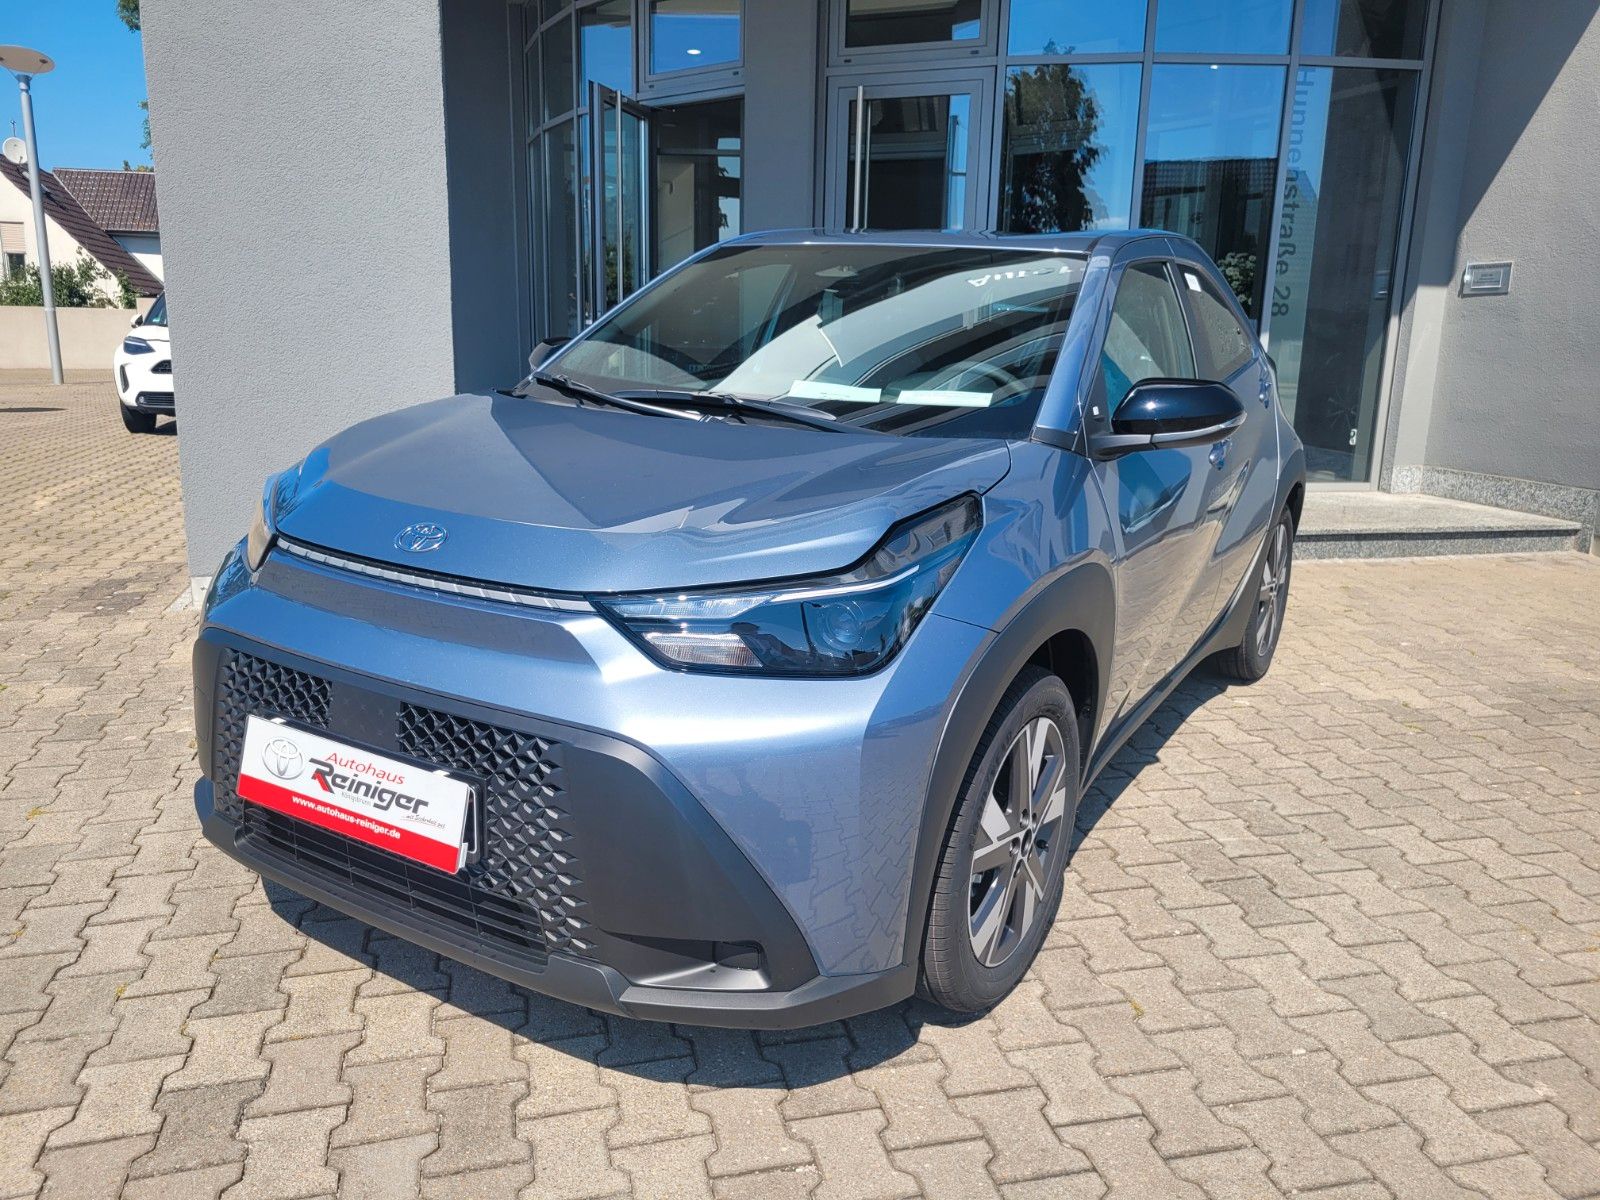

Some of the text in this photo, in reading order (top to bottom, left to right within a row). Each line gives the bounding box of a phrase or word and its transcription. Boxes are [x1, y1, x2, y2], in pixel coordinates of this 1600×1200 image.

[1271, 68, 1314, 317] Hunnenstraße 28
[308, 757, 430, 815] Reiniger
[325, 752, 406, 786] Autohaus
[291, 795, 401, 840] www.autohaus-reiniger.de
